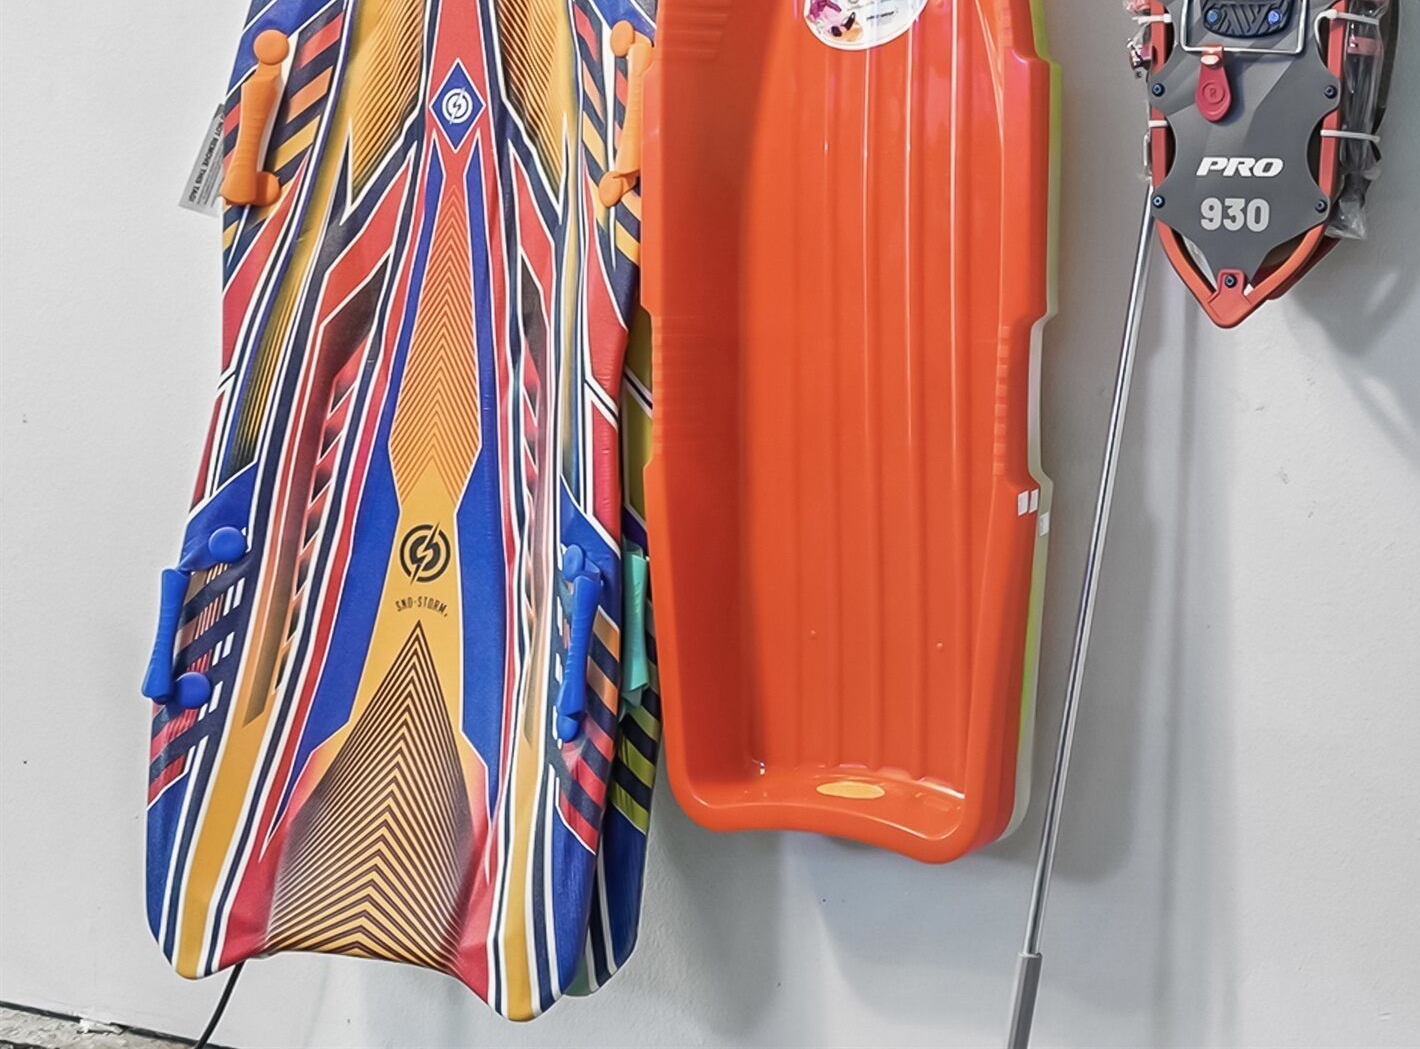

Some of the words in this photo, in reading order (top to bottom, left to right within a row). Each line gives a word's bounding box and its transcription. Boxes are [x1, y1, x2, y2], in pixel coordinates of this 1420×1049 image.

[202, 137, 219, 168] REMOVE
[195, 168, 207, 185] THIS
[1196, 157, 1284, 177] PRO
[1200, 197, 1270, 232] 930
